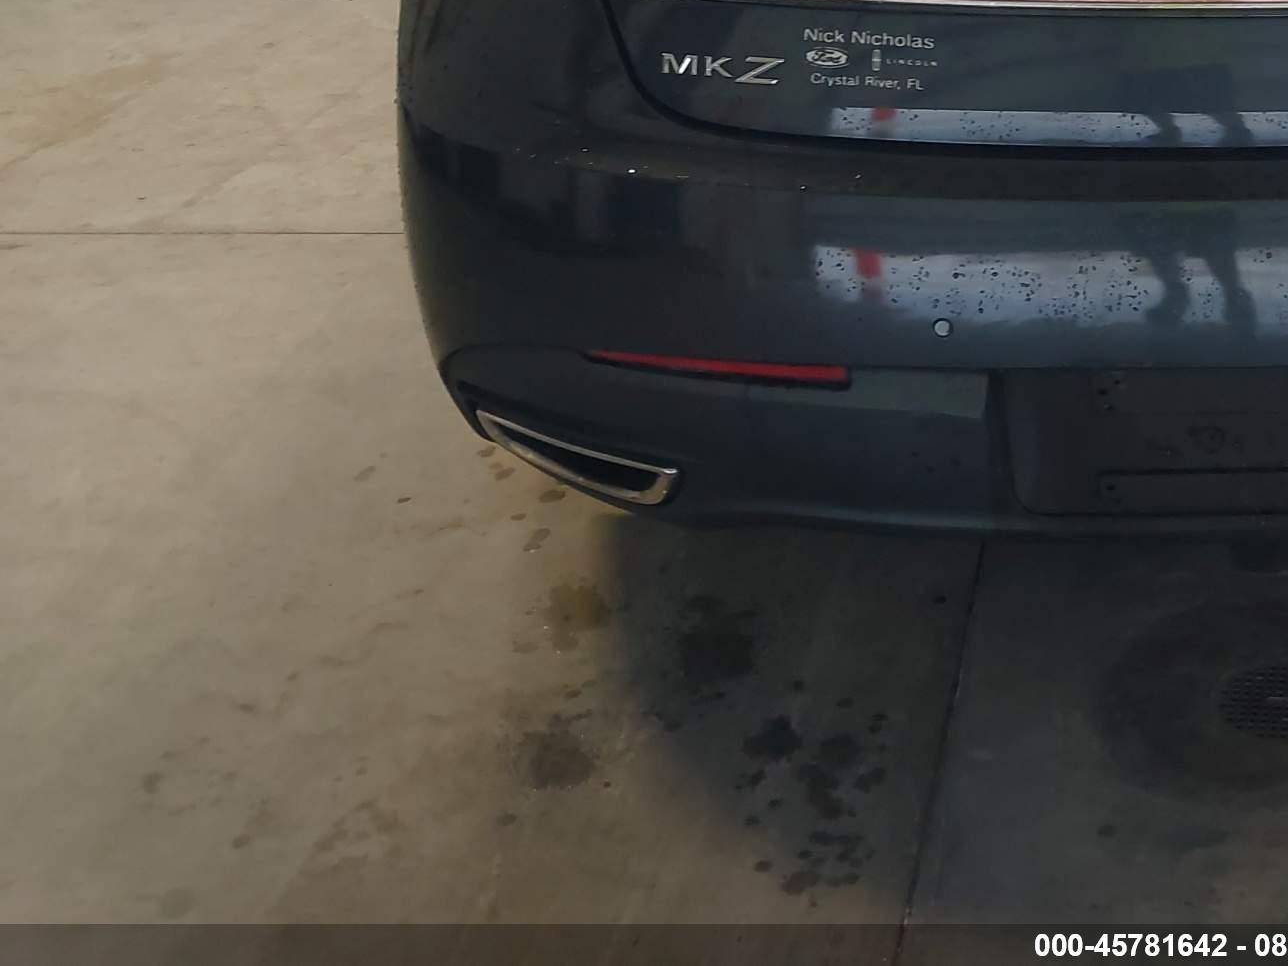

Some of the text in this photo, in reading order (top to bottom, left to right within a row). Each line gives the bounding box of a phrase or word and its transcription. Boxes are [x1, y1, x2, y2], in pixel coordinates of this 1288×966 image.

[803, 28, 935, 49] Nick Nicholas
[661, 52, 784, 84] MKZ
[810, 72, 925, 91] Crystal River, FL
